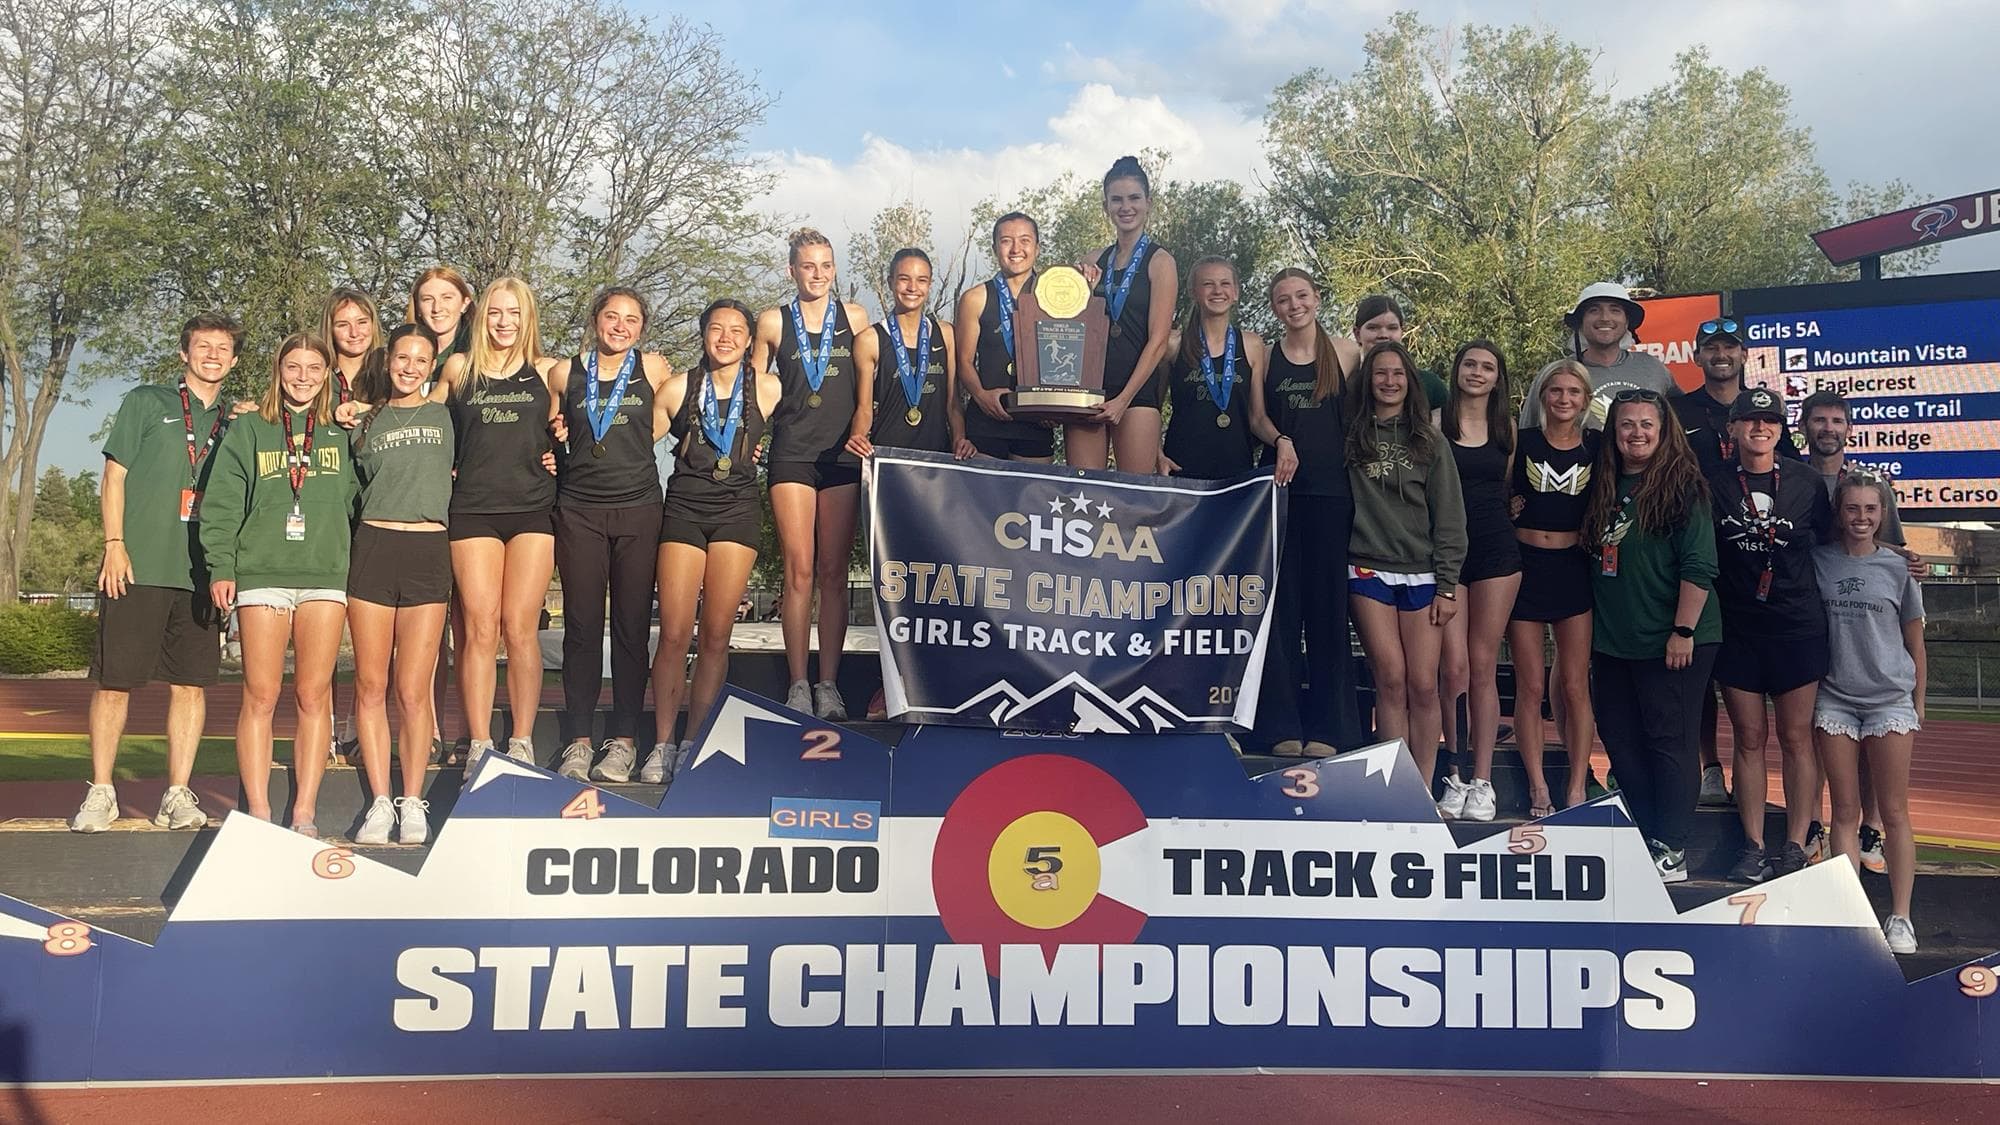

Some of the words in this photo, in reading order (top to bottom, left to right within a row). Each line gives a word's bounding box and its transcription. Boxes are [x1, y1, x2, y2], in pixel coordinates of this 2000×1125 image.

[1748, 323, 1791, 341] Girls
[1796, 321, 1821, 338] 5A
[1757, 353, 1766, 369] 1
[1814, 347, 1910, 367] Mountain
[1915, 344, 1968, 362] Vista
[466, 389, 535, 406] Mountain
[1815, 375, 1916, 396] Eaglecrest
[481, 407, 520, 424] Vista
[1852, 402, 1910, 420] rokee
[1914, 398, 1961, 418] Trail
[1844, 431, 1869, 448] sil
[1876, 430, 1931, 450] Ridge
[1895, 486, 1933, 503] n-Ft
[993, 511, 1164, 564] CHSAA
[1737, 539, 1774, 552] vist
[880, 560, 1012, 609] STATE
[1026, 571, 1265, 620] CHAMPIONS
[889, 616, 992, 648] GIRLS
[1003, 623, 1117, 657] TRACK
[1127, 632, 1152, 657] &
[1164, 629, 1254, 656] FIELD
[1209, 686, 1240, 704] 20
[800, 728, 843, 761] 2
[1280, 767, 1320, 800] 3
[560, 786, 607, 821] 4
[772, 809, 874, 830] GIRLS
[1506, 825, 1547, 855] 5
[312, 846, 356, 880] 6
[526, 846, 880, 895] COLORADO
[1023, 846, 1063, 875] 5
[1163, 848, 1378, 898] TRACK
[1390, 852, 1434, 899] &
[1444, 853, 1607, 901] FIELD
[1727, 892, 1767, 926] 7
[44, 920, 93, 957] 8
[393, 945, 748, 1032] STATE
[768, 943, 1697, 1031] CHAMPIONSHIPS
[1958, 965, 1998, 997] 9
